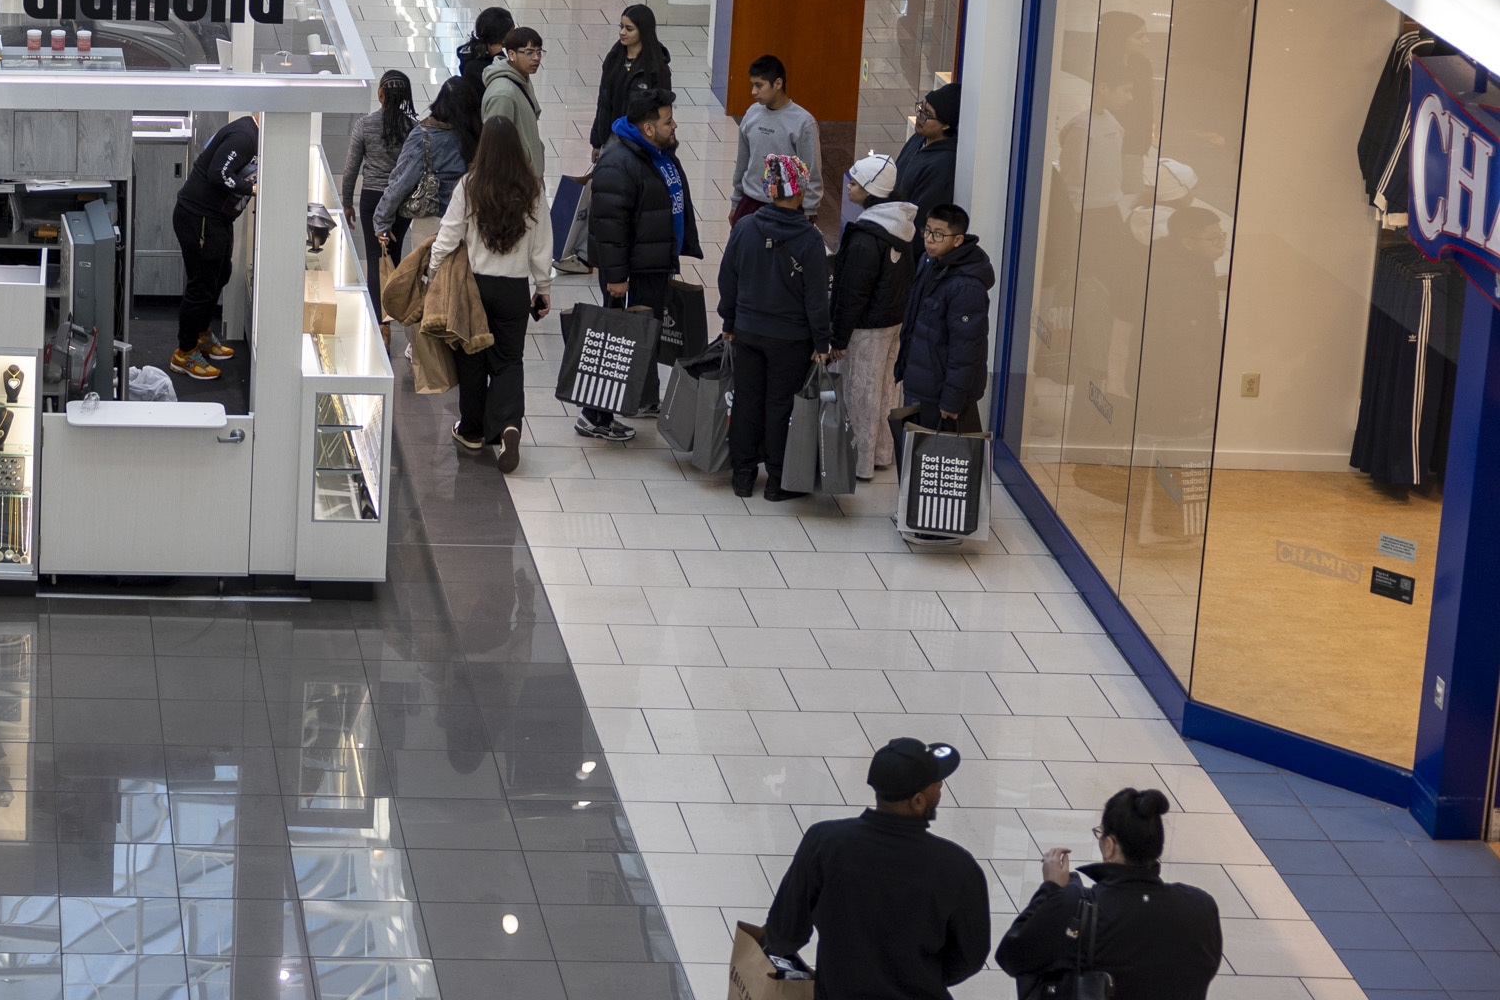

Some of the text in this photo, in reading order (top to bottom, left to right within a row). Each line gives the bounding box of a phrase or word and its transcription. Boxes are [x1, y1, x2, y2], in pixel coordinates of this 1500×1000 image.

[1412, 93, 1500, 258] CH
[585, 328, 637, 347] Foot Locker
[660, 335, 684, 346] NEAKERS
[662, 328, 683, 339] HEART
[583, 336, 635, 356] Foot Locker
[581, 345, 632, 364] Foot Locker
[580, 353, 631, 372] Foot Locker
[578, 362, 629, 381] Foot Locker
[921, 454, 969, 466] Foot Locker
[921, 462, 969, 474] Foot Locker
[920, 470, 968, 482] Foot Locker
[919, 486, 967, 497] Foot Locker
[920, 478, 968, 490] Foot Locker
[1276, 542, 1361, 583] CHAMPS
